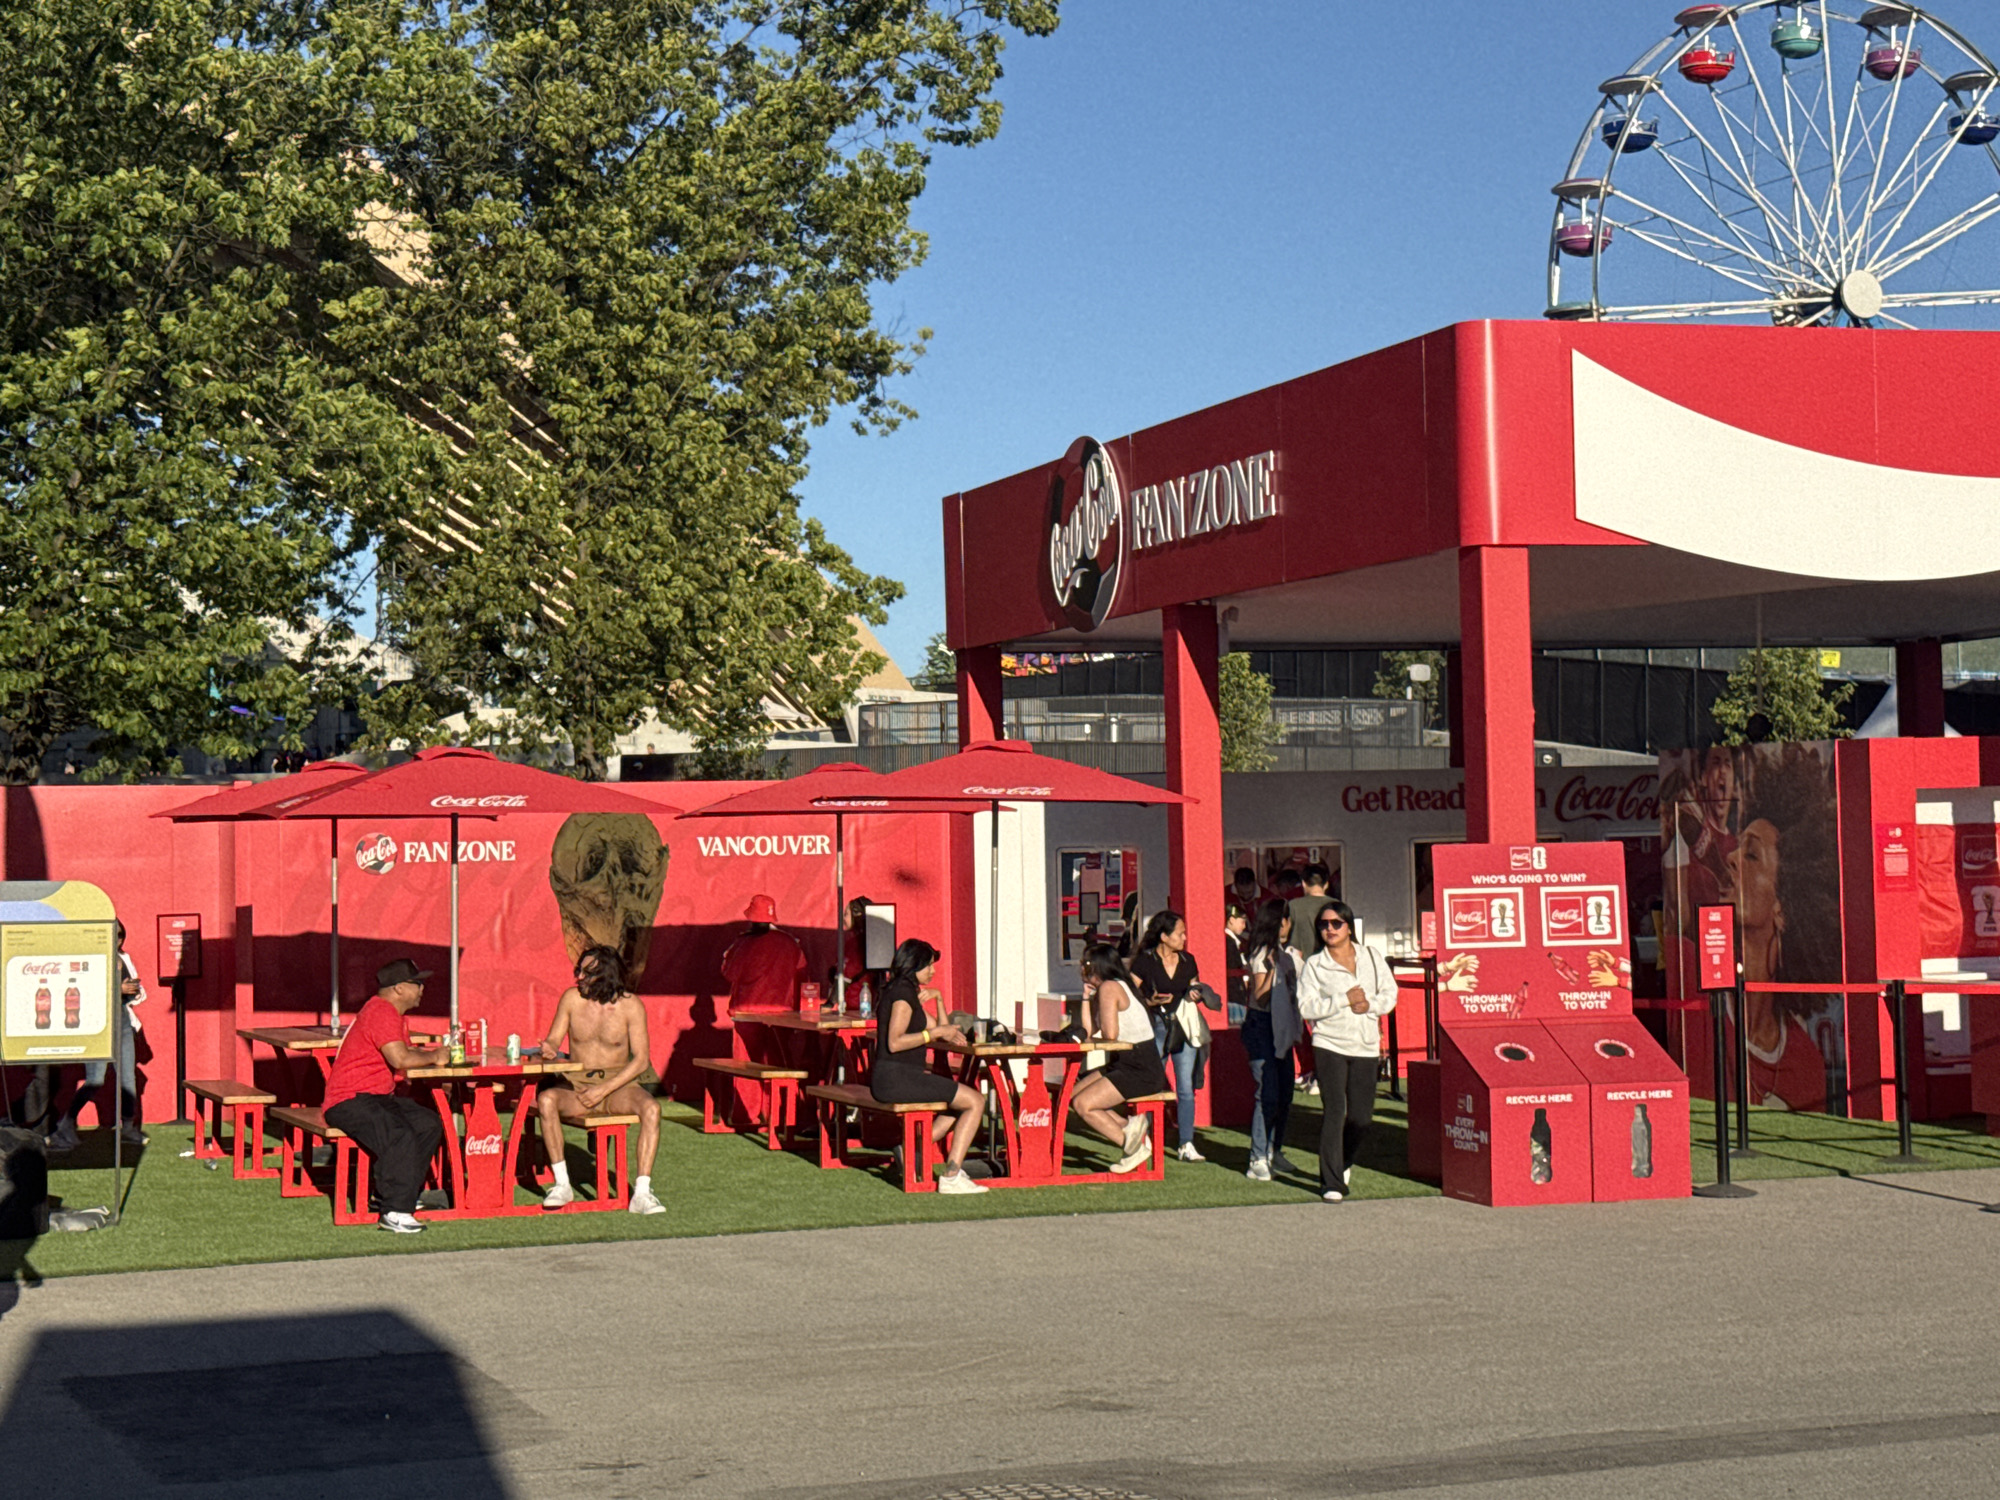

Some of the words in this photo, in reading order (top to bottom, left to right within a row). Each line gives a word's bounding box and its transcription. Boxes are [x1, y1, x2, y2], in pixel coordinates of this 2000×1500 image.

[1131, 476, 1186, 550] FAN
[1188, 450, 1276, 538] ZONE
[962, 785, 1055, 796] Coca-Cola
[430, 795, 529, 807] Coca-Cola
[1342, 785, 1391, 813] Get
[1395, 784, 1466, 812] Read
[1554, 775, 1661, 822] Coca-Col
[404, 841, 449, 863] FAN
[457, 840, 516, 862] ZONE
[697, 835, 831, 857] VANCOUVER
[1472, 875, 1507, 884] WHO'S
[1509, 874, 1543, 884] GOING
[1544, 873, 1558, 883] TO
[1560, 873, 1587, 882] WIN?
[1458, 994, 1512, 1004] THROW-IN
[1558, 991, 1611, 1001] THROW-IN
[1464, 1004, 1480, 1013] TO
[1481, 1003, 1508, 1013] VOTE
[1563, 1001, 1579, 1010] TO
[1581, 1000, 1608, 1010] VOTE
[1505, 1095, 1547, 1105] RECYCLE
[1548, 1094, 1573, 1103] HERE
[1606, 1091, 1647, 1101] RECYCLE
[1648, 1090, 1673, 1099] HERE
[1455, 1116, 1475, 1127] EVERY
[1444, 1124, 1488, 1144] THROW-IN
[1453, 1140, 1479, 1152] COUNTS
